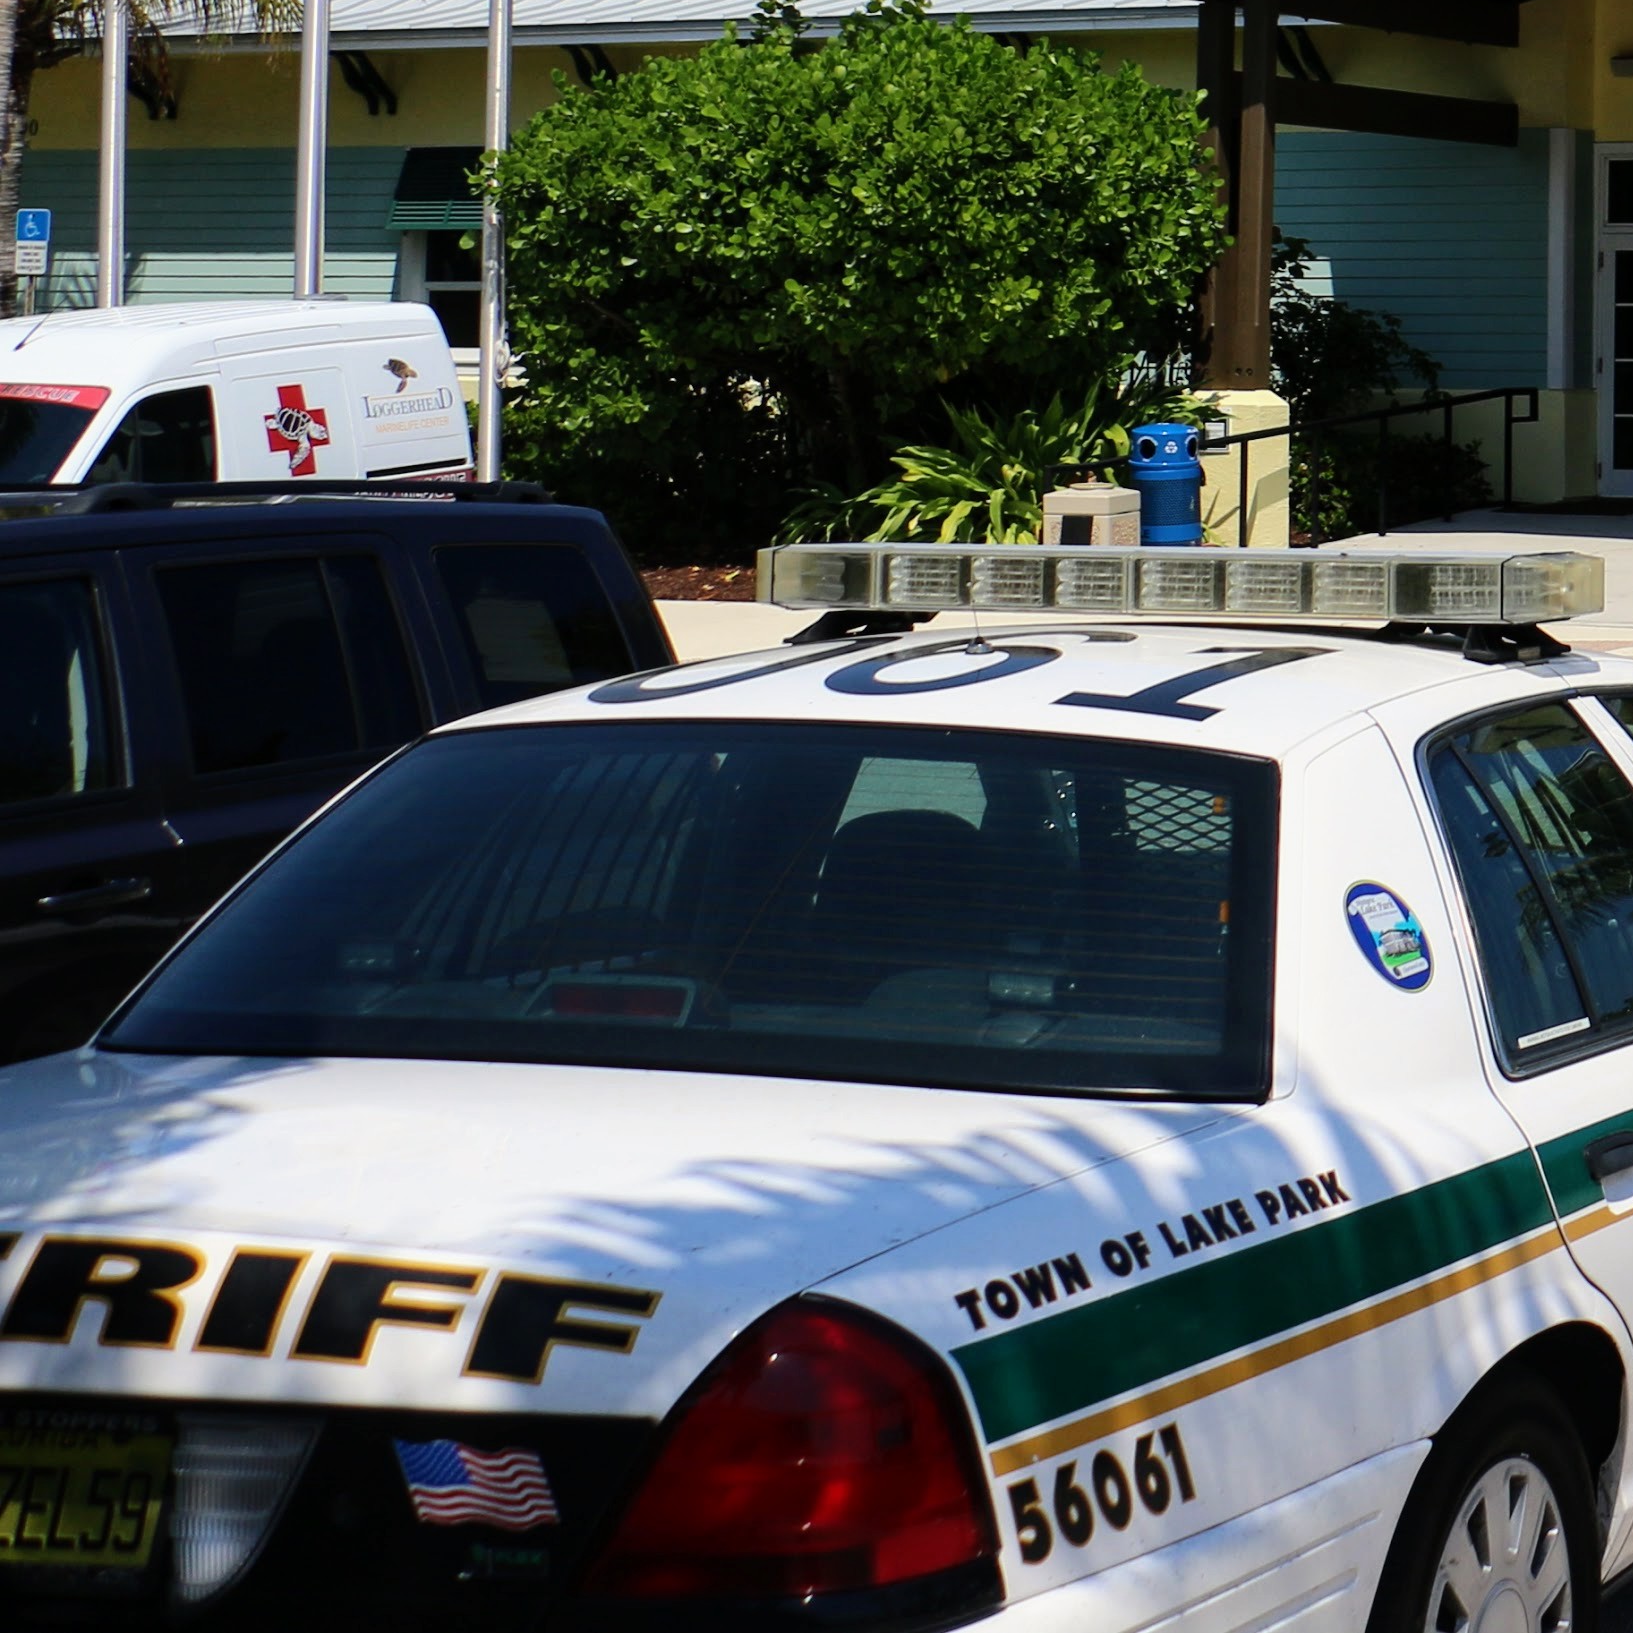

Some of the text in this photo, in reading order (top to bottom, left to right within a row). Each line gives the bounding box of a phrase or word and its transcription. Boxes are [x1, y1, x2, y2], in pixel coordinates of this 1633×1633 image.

[360, 387, 454, 419] LOGGERHEAD
[375, 416, 450, 433] MARINELIFE CENTER
[0, 1231, 663, 1385] RIFF
[953, 1169, 1352, 1331] TOWN OF LAKE PARK
[1006, 1421, 1197, 1565] 56061
